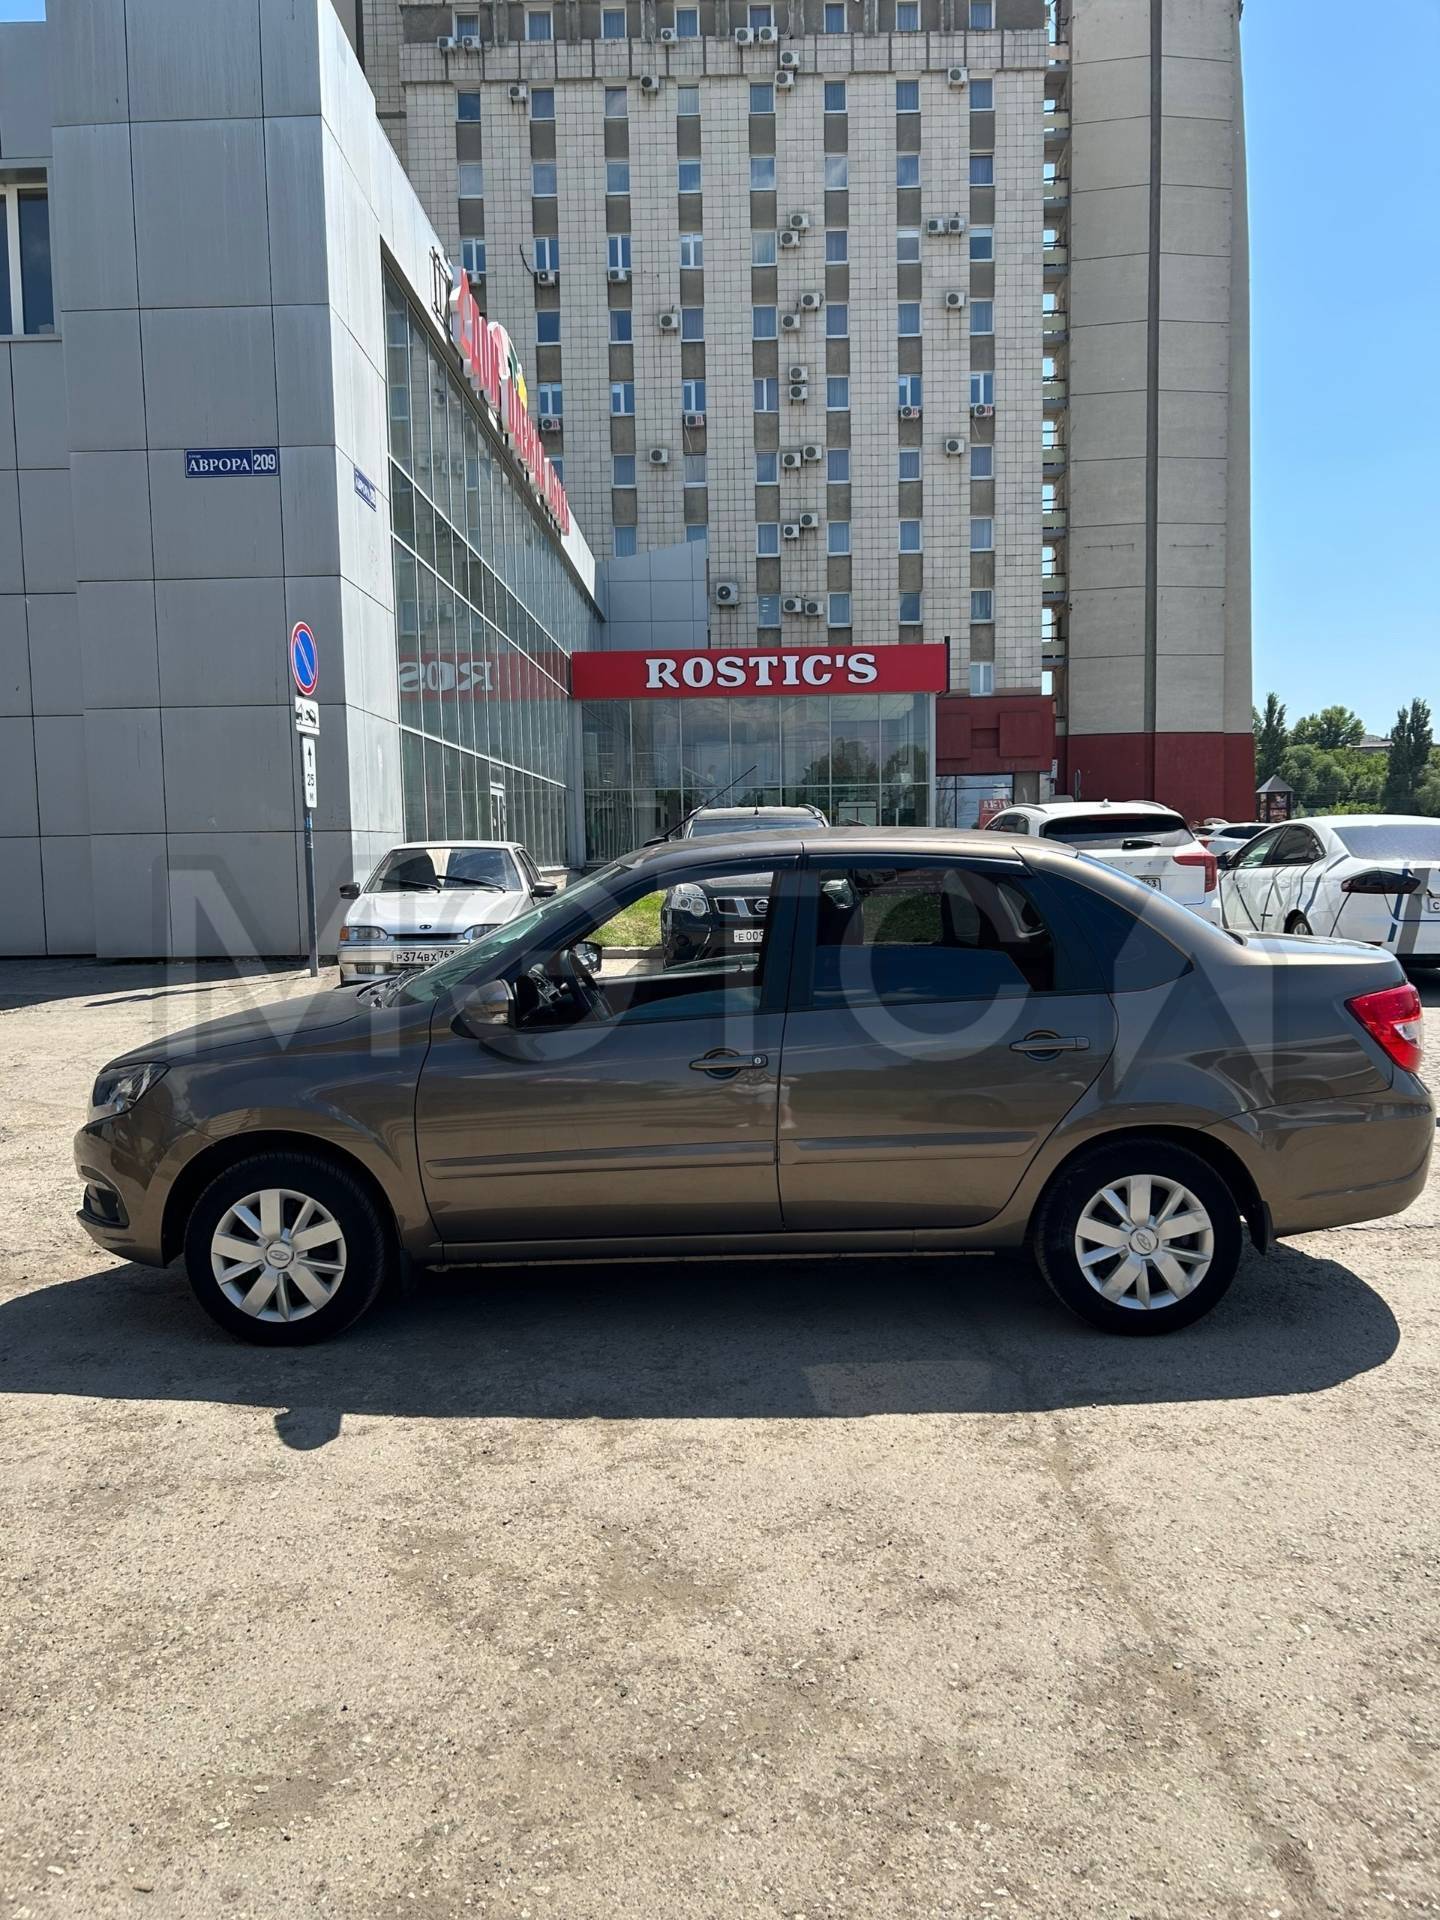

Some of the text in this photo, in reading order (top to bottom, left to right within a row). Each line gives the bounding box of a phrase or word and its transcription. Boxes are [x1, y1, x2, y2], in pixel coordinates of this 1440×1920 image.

[188, 454, 276, 472] АВРОРА 209
[645, 653, 878, 688] ROSTIC'S
